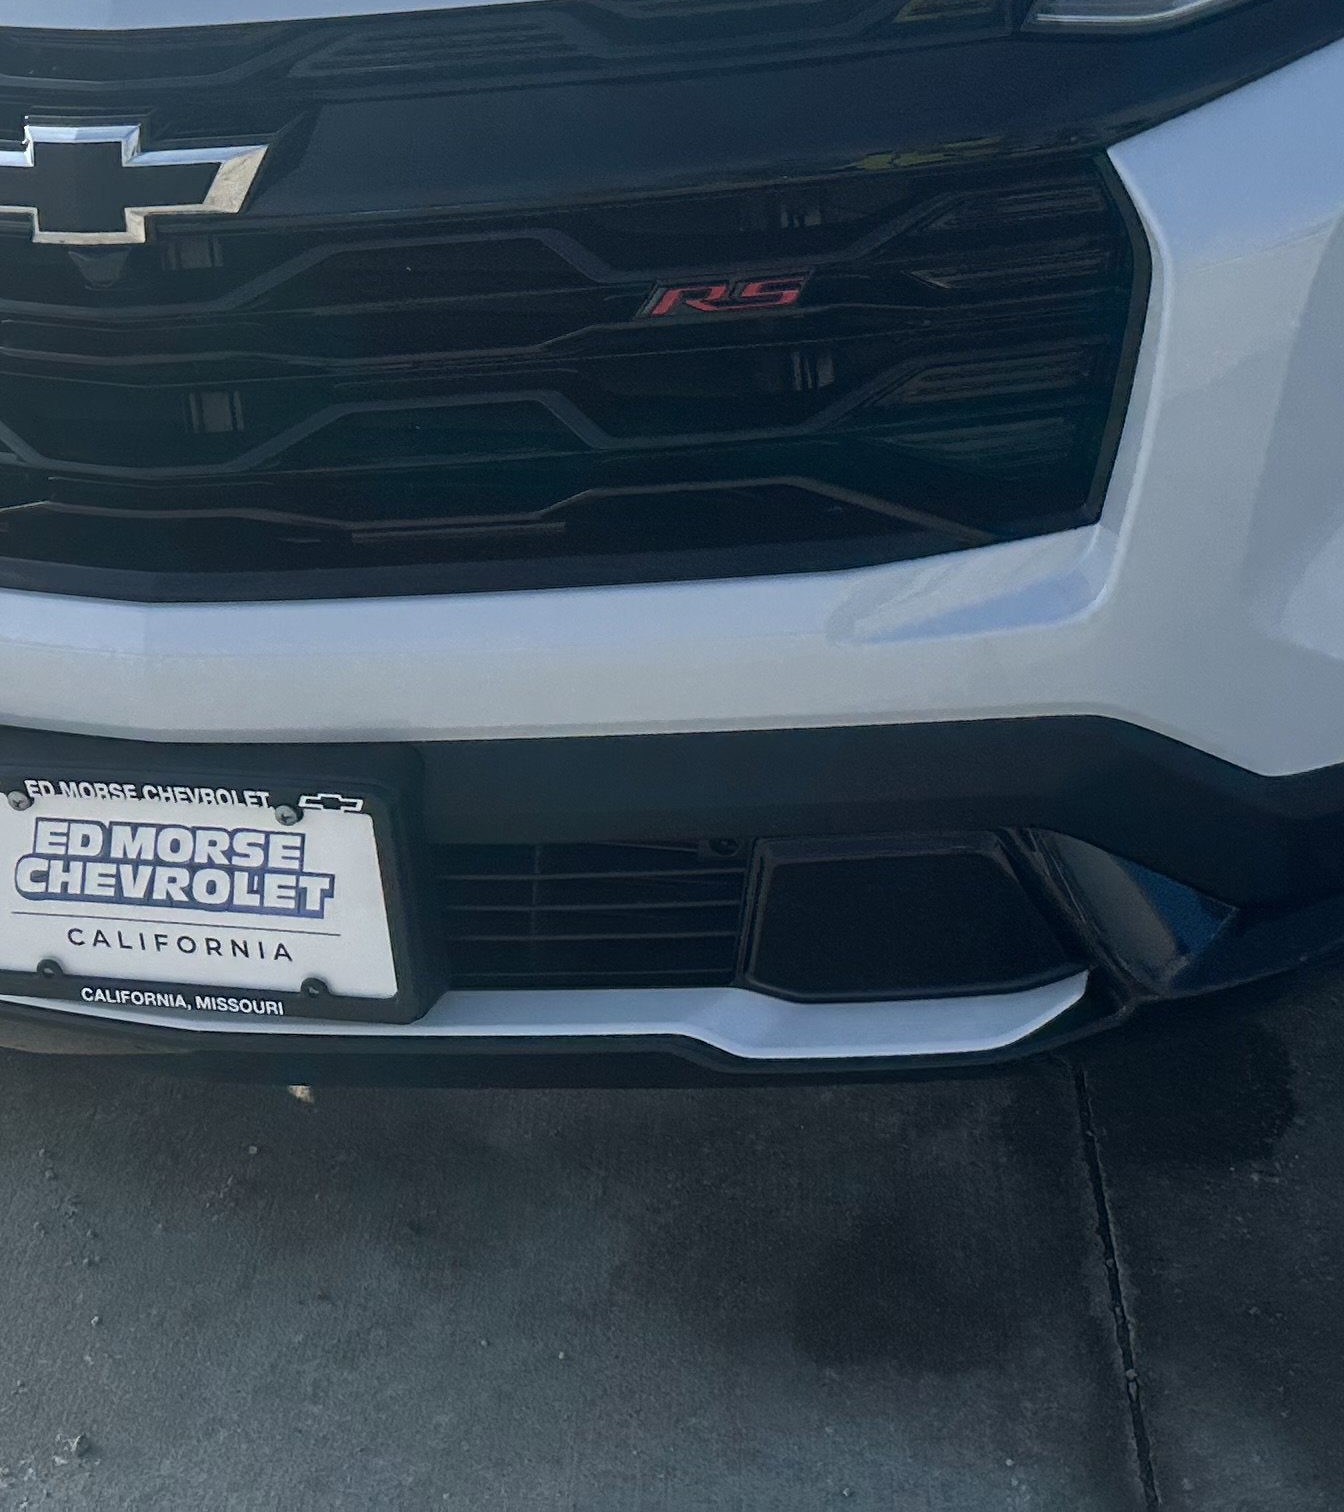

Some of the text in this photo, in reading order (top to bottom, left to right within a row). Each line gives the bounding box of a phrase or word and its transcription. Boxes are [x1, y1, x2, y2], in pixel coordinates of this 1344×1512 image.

[640, 274, 809, 319] RS
[24, 779, 272, 809] ED MORSE CHEVROLET
[33, 817, 304, 869] ED MORSE
[15, 854, 334, 918] CHEVROLET
[67, 927, 293, 962] CALIFORNIA
[81, 987, 284, 1016] CALIFORNIA, MISSOURI
